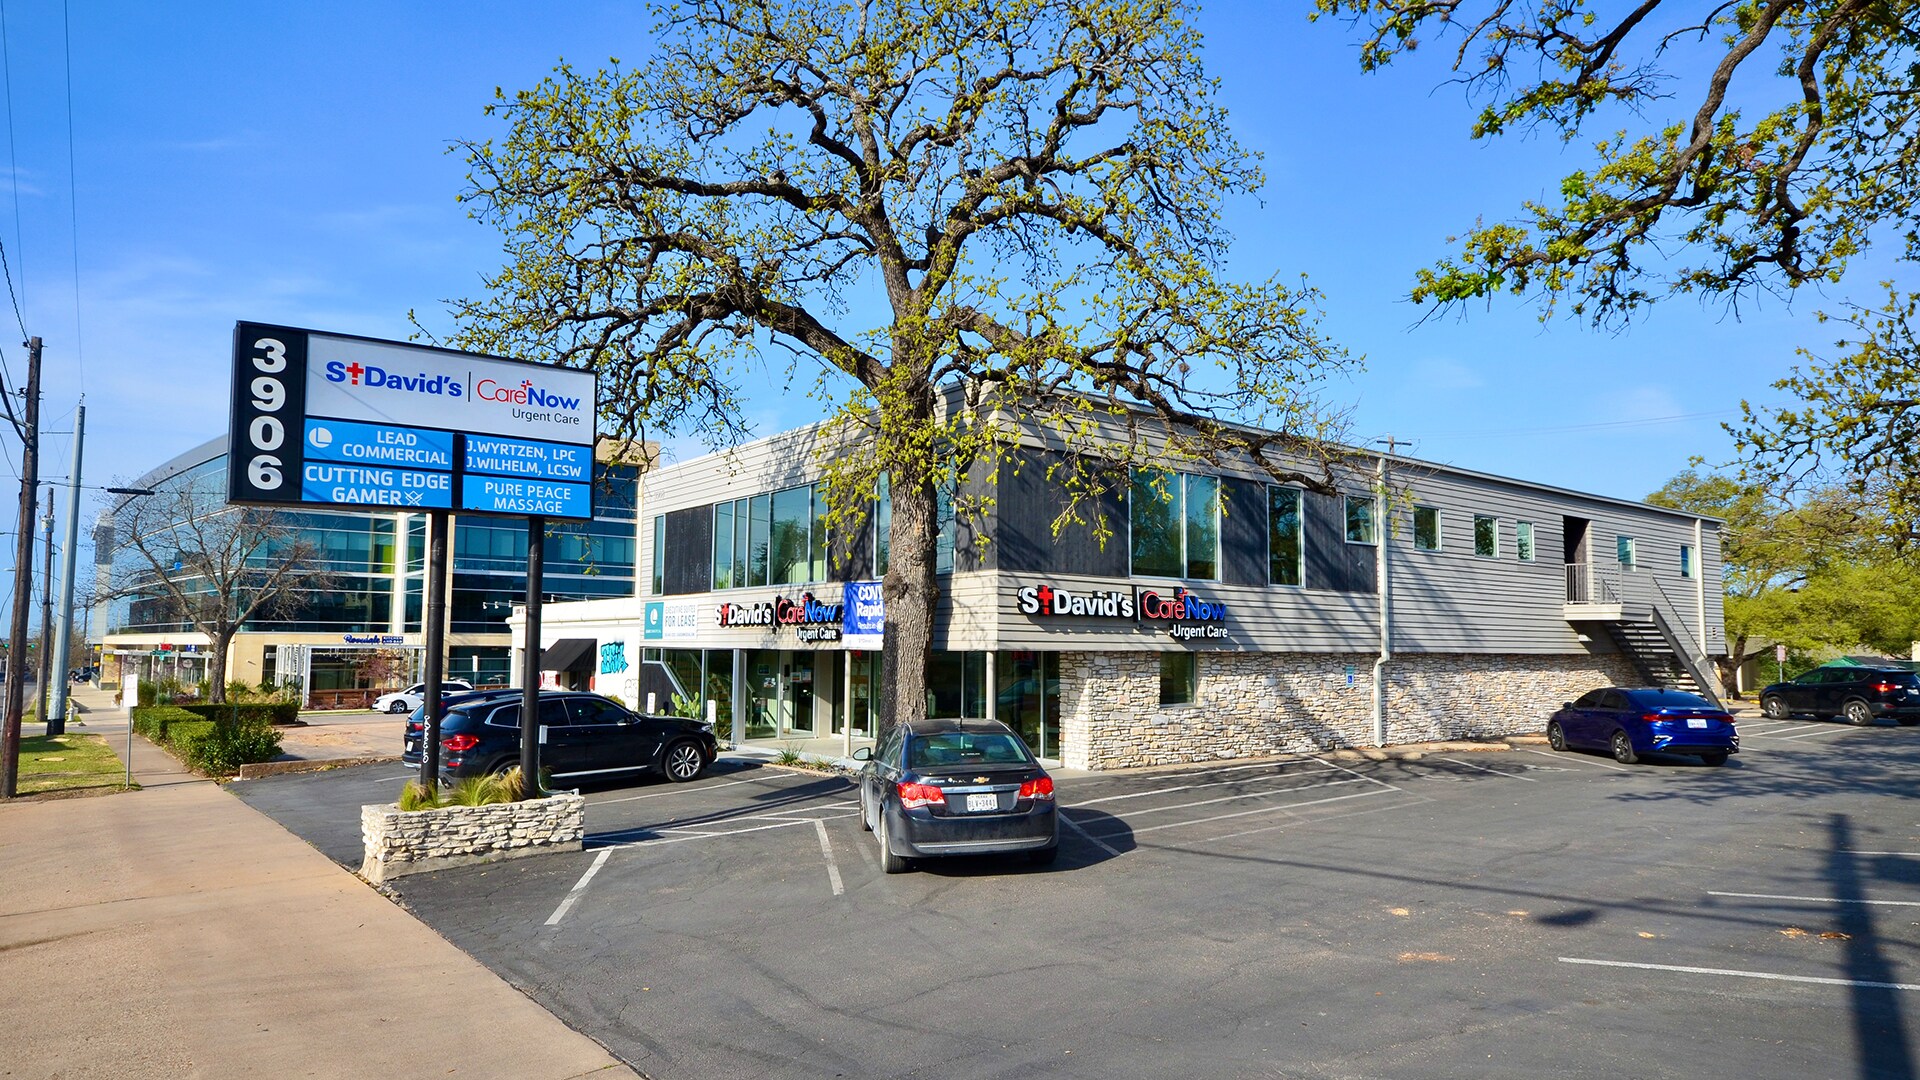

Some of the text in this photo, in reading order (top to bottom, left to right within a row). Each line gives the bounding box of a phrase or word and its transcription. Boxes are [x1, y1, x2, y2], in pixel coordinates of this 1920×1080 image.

[248, 338, 287, 490] 3906
[512, 408, 580, 425] Urgent Care
[377, 430, 417, 446] LEAD
[342, 443, 449, 465] COMMERCIAL
[553, 449, 576, 461] LPC
[305, 465, 449, 490] CUTTING EDGE
[547, 464, 582, 477] LCSW
[332, 487, 402, 505] GAMER
[485, 482, 571, 500] PURE PEACE
[493, 497, 563, 513] MASSAGE
[857, 585, 884, 601] COVI
[856, 600, 884, 620] Rapid
[665, 614, 695, 627] FOR LEASE
[796, 627, 837, 641] Urgent Care
[1207, 625, 1228, 638] Care
